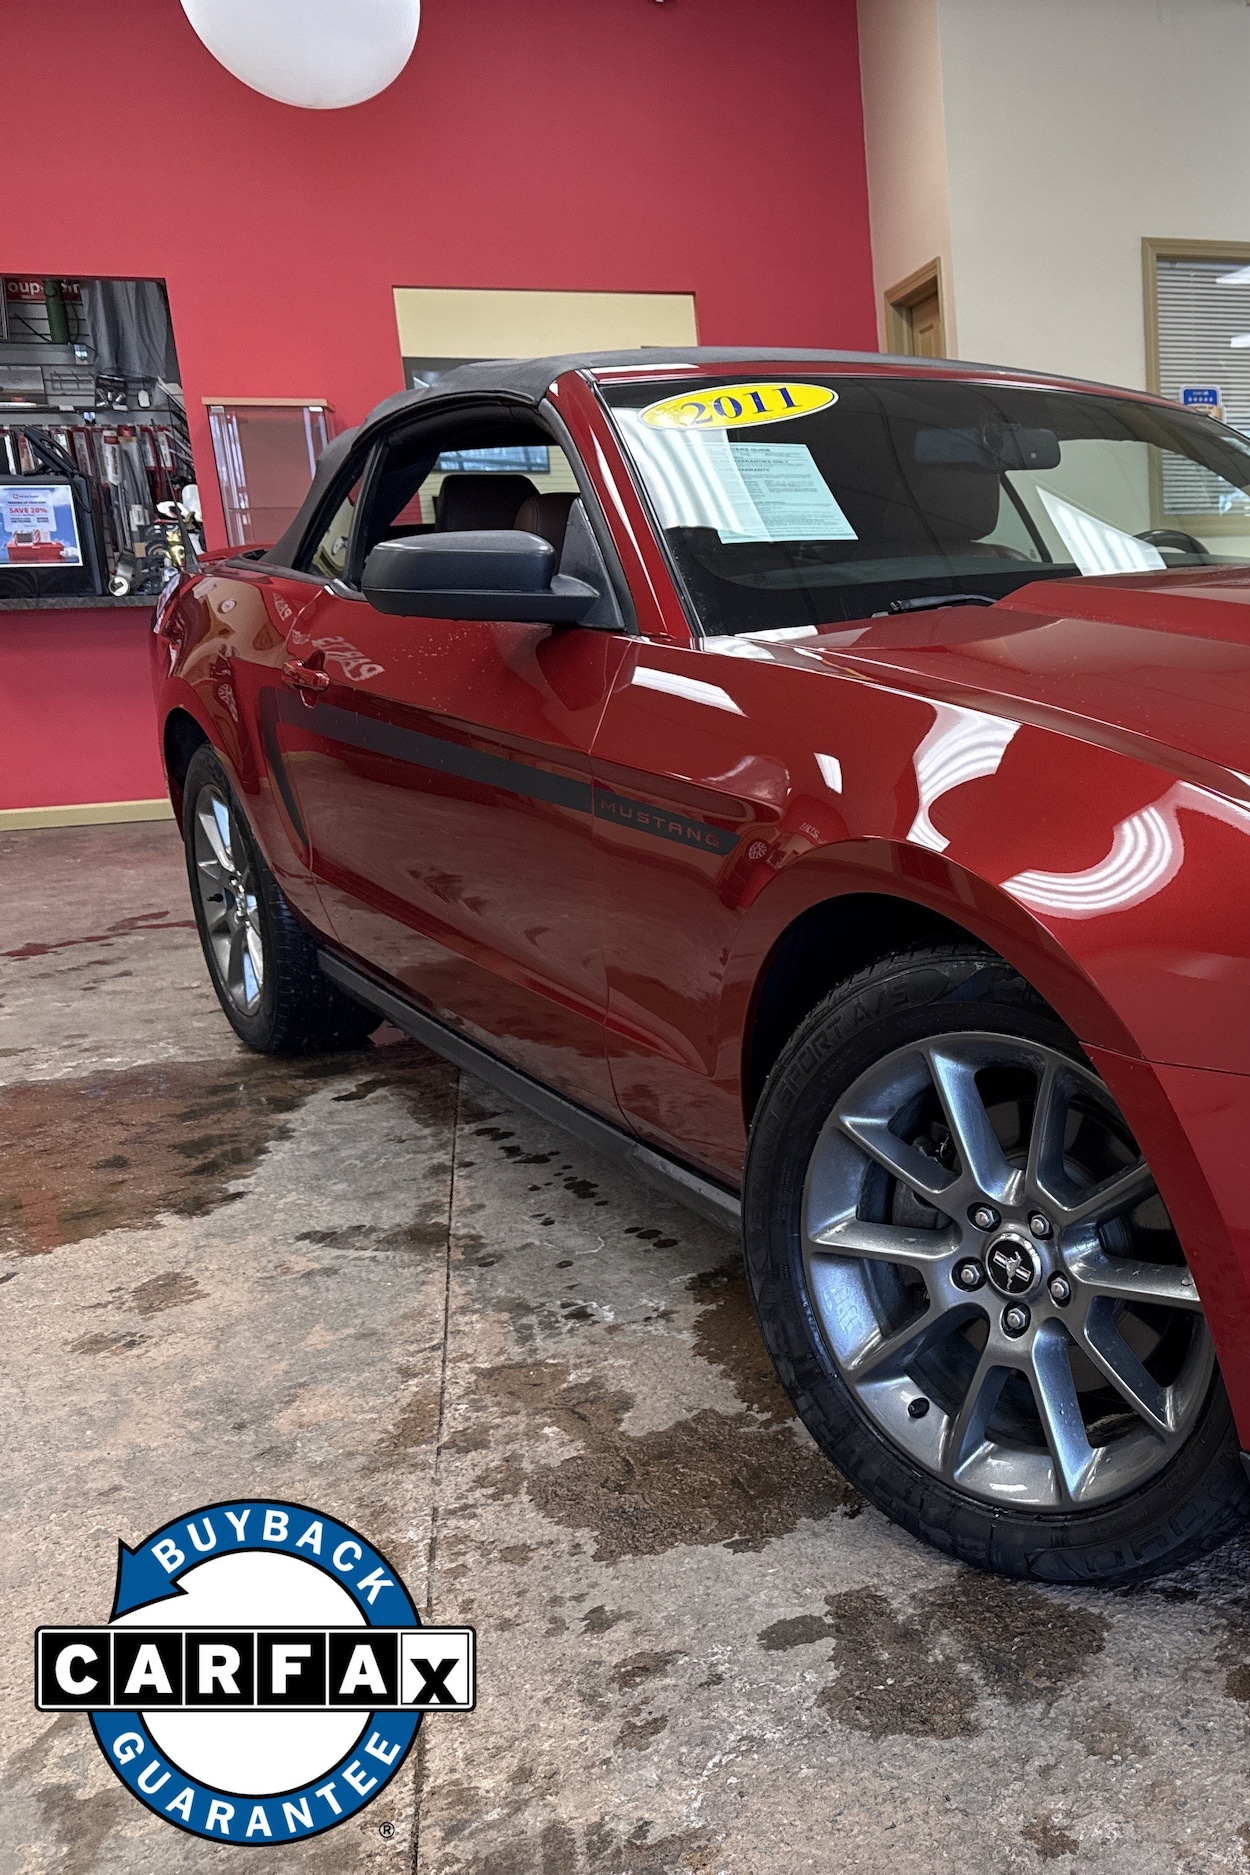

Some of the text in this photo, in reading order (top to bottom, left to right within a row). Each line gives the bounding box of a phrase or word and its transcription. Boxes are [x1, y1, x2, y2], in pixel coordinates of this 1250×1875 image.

[680, 387, 802, 426] 2011
[600, 799, 721, 848] MUSTANG
[775, 1014, 849, 1110] SPORT
